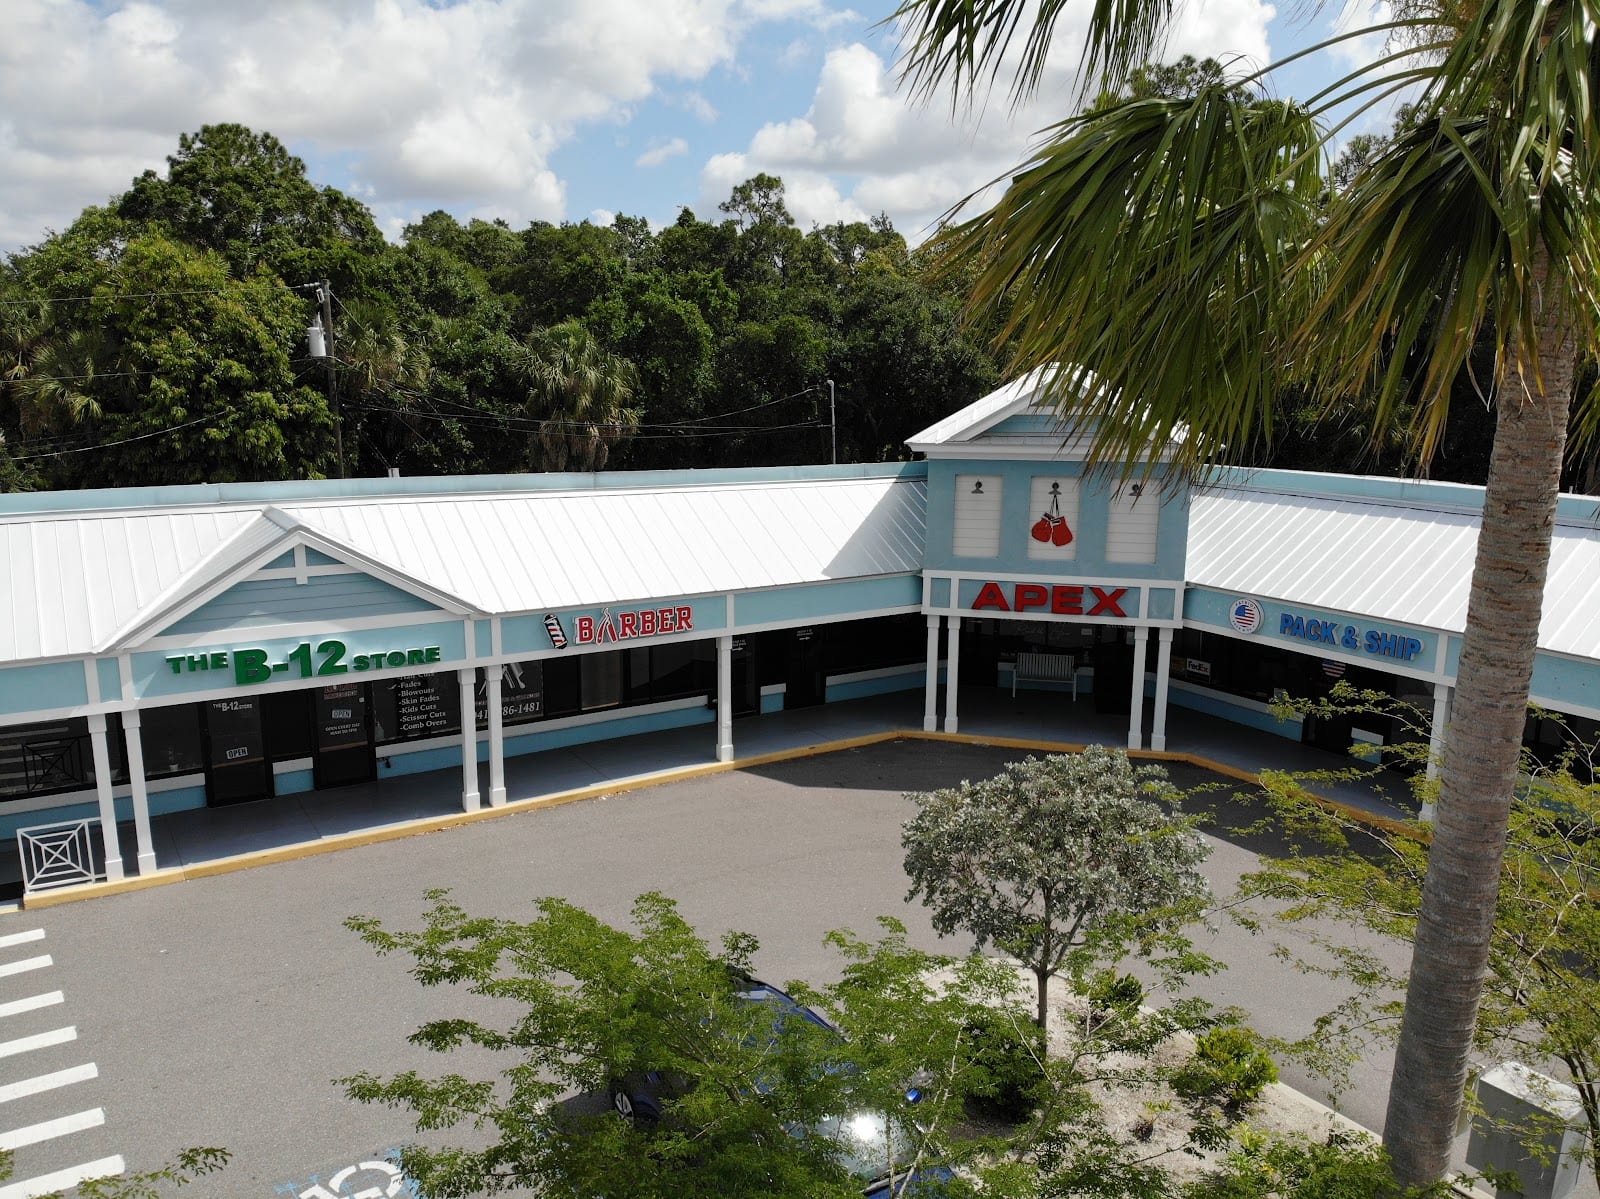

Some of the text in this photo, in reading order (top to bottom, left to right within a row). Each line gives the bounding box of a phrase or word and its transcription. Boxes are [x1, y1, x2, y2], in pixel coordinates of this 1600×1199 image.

[971, 582, 1129, 618] APEX
[575, 608, 693, 644] BARBER
[1280, 613, 1423, 661] PACK & SHIP
[165, 639, 441, 685] THE B-12 STORE
[419, 695, 440, 703] Fades
[222, 701, 239, 712] B-12
[502, 701, 541, 716] 86-1481
[332, 709, 351, 719] OPEN
[429, 711, 446, 719] Cuts
[425, 719, 447, 727] Overs
[228, 748, 247, 760] OPEN
